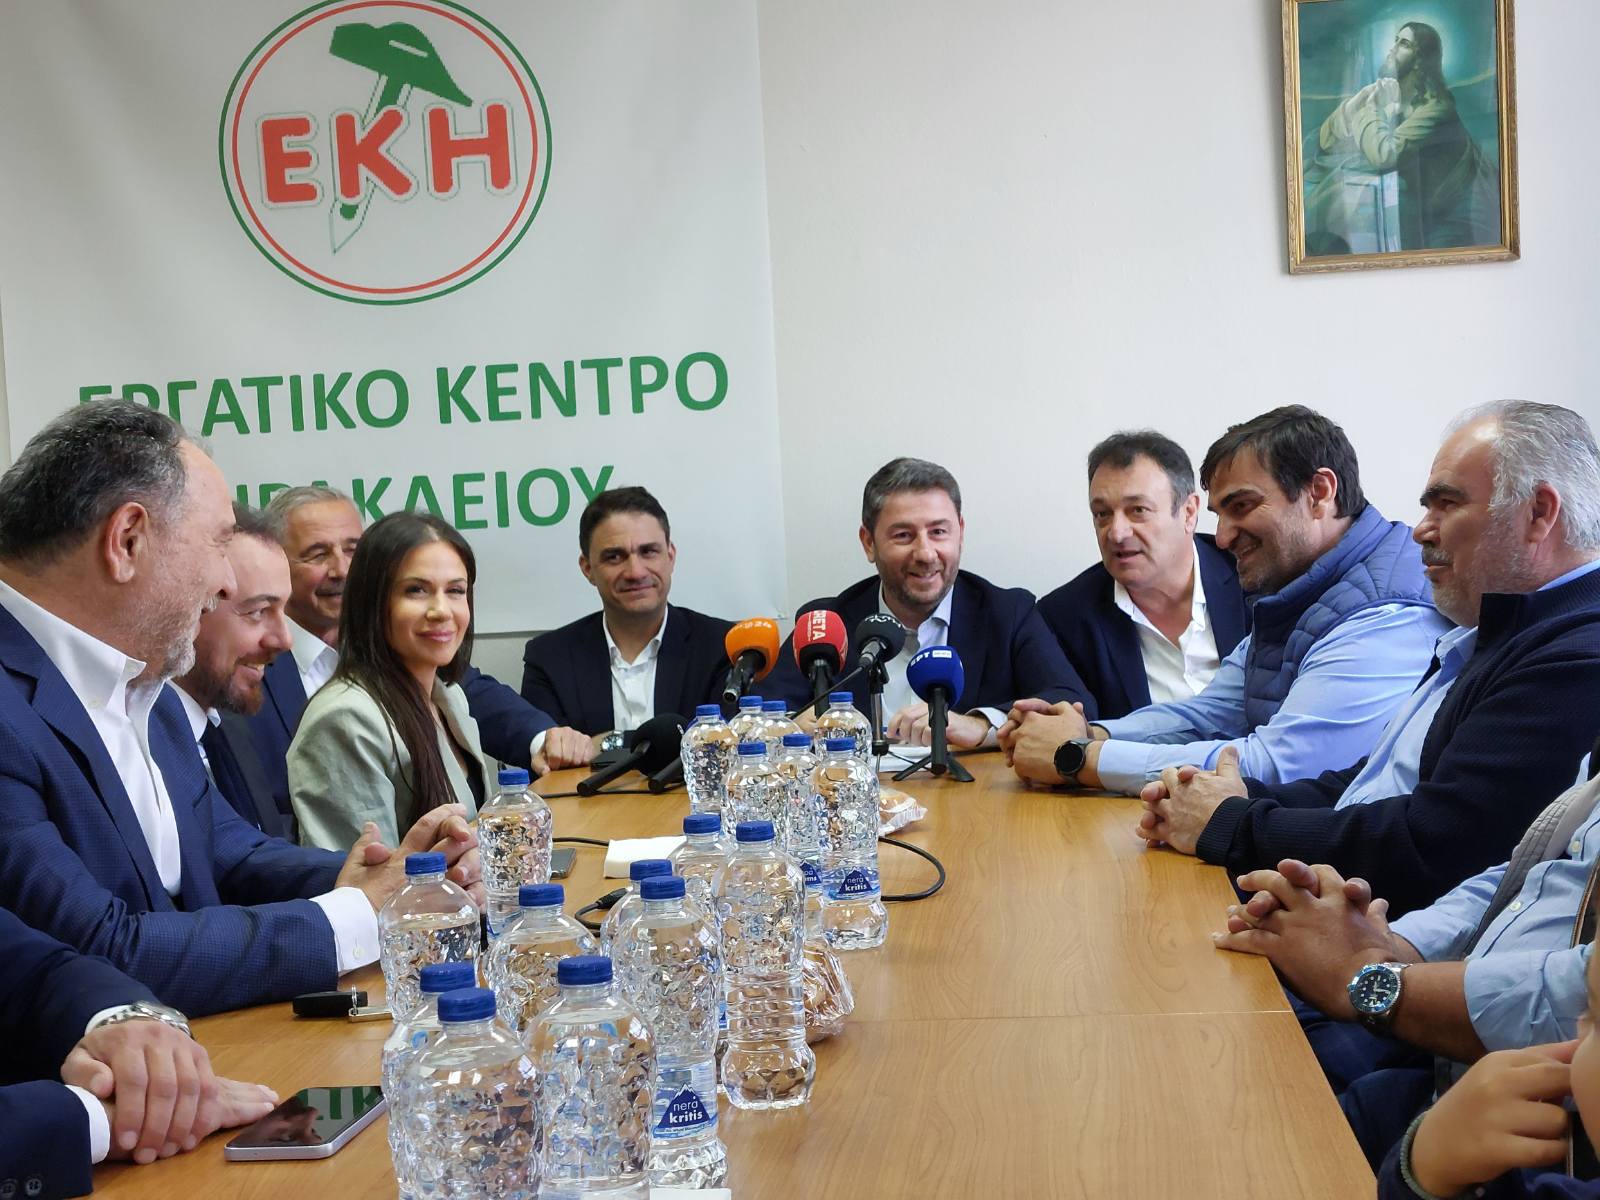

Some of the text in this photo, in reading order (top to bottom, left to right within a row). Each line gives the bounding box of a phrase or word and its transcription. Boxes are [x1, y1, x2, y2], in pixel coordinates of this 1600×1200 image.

[260, 103, 512, 204] ΕΚΗ
[80, 351, 729, 437] ΓΑΤΙΚΟ ΚΕΝΤΡΟ
[236, 464, 615, 531] ΚΛΕΙΟΥ
[844, 883, 868, 892] kritis
[669, 1110, 703, 1124] kritis
